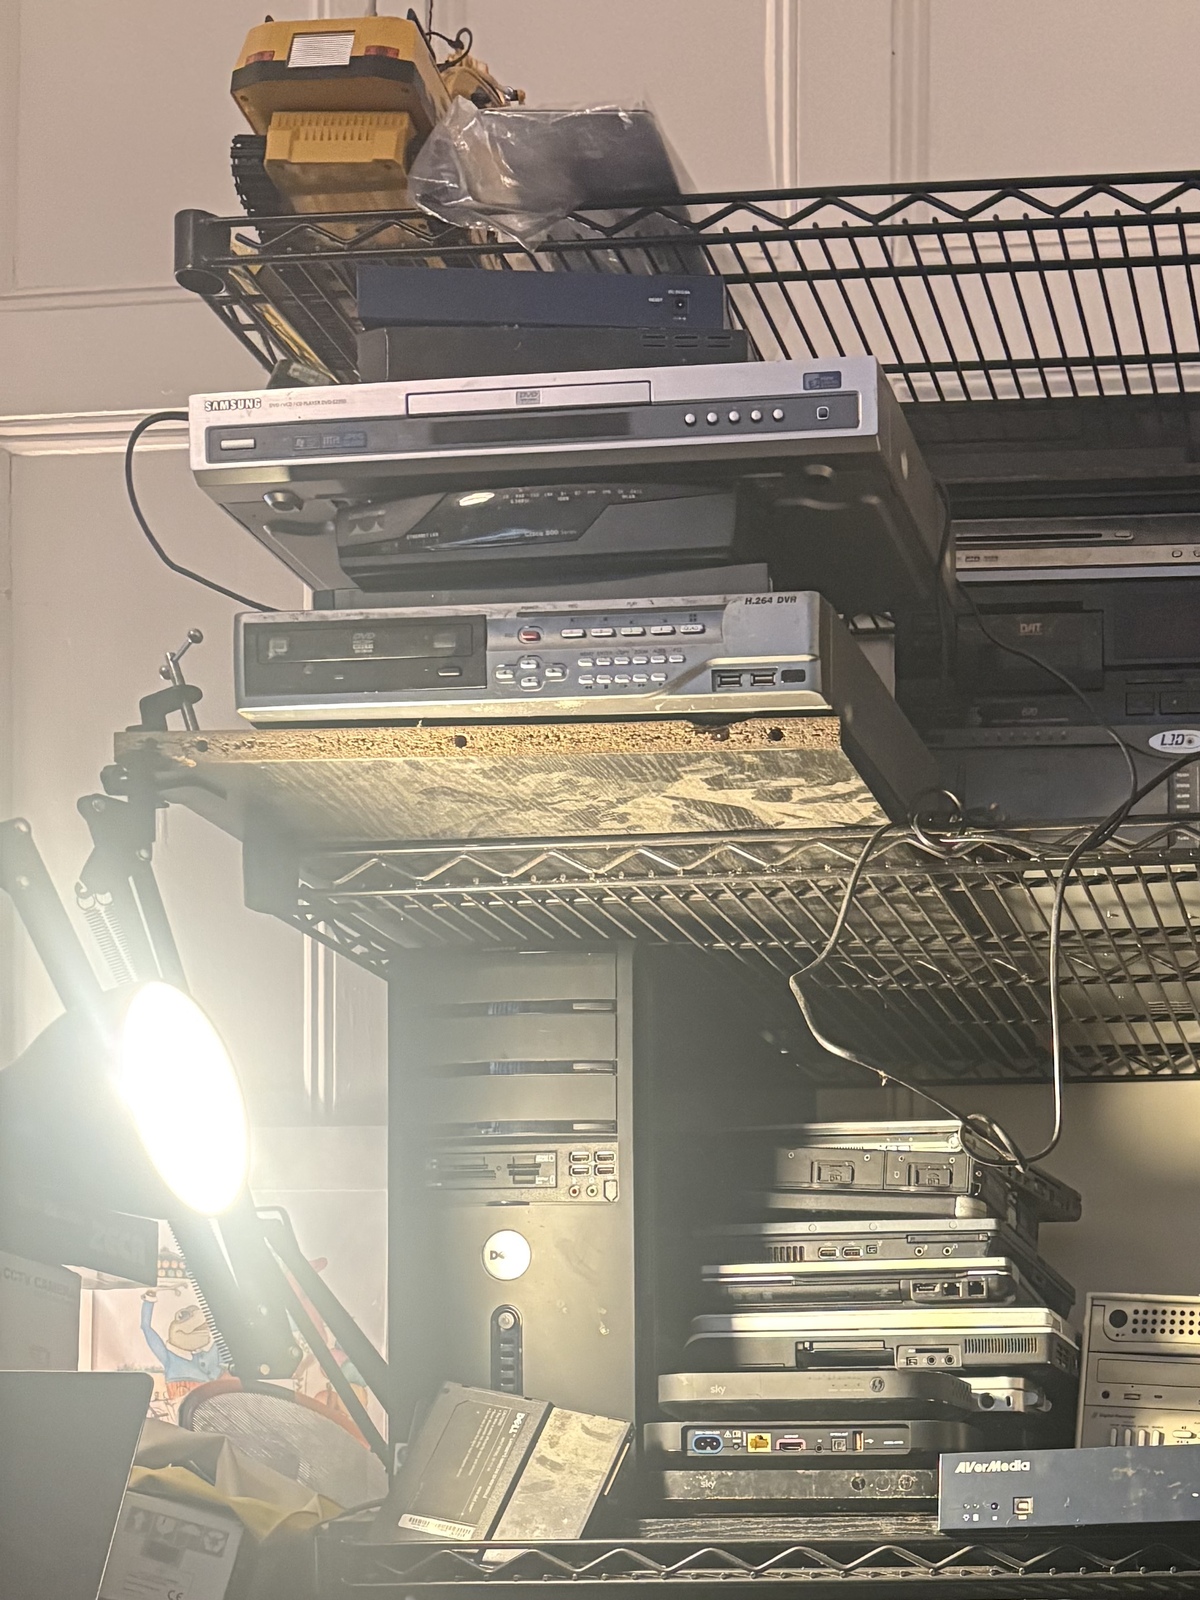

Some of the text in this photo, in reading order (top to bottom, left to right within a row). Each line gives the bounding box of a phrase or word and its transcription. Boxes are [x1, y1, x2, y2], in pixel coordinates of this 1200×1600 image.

[204, 398, 262, 412] SAMSUNG
[744, 596, 797, 605] H.264 DVR
[710, 1384, 726, 1396] sky
[509, 1412, 526, 1435] DELL
[954, 1458, 1031, 1474] AVerMedia
[700, 1479, 716, 1490] sky
